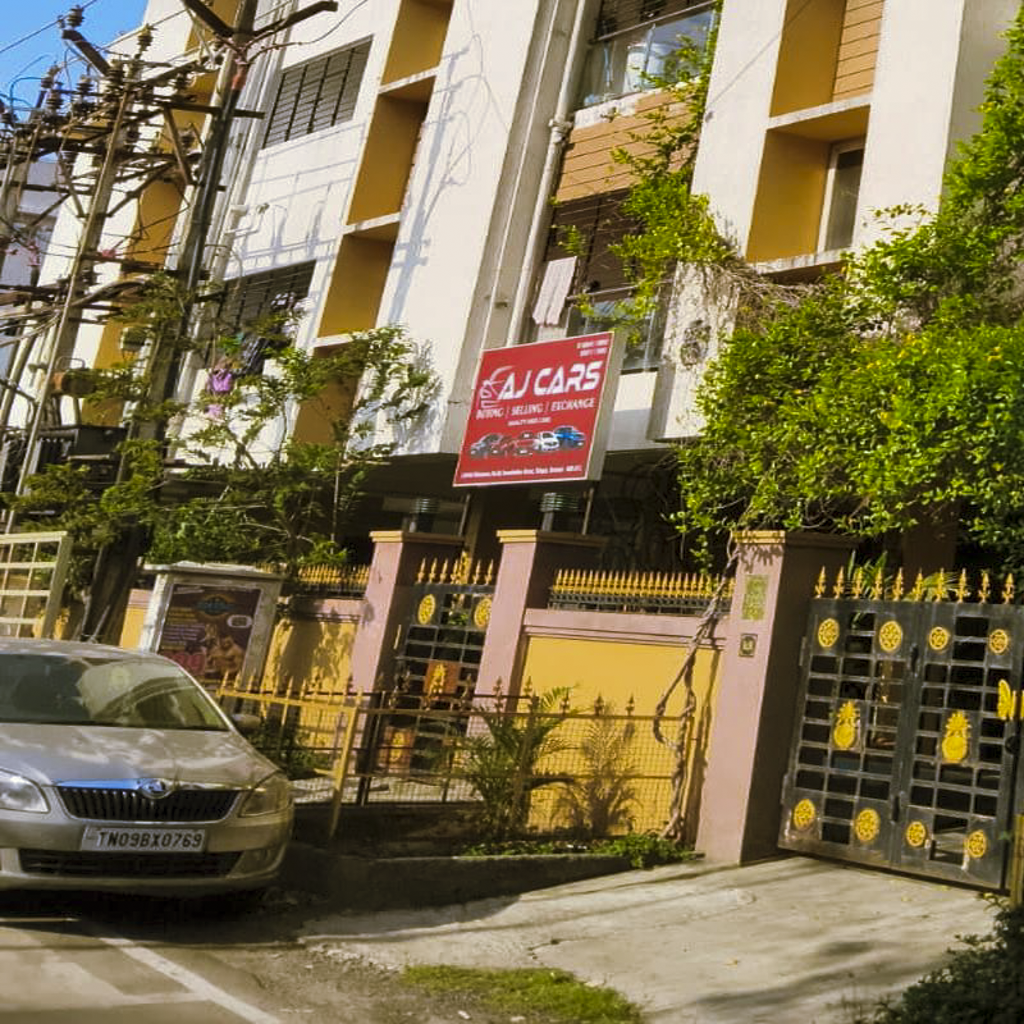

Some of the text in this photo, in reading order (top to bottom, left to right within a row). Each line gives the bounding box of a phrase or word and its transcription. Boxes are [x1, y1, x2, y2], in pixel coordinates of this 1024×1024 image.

[497, 361, 603, 400] AJ CARS
[511, 403, 544, 416] SELLING
[551, 397, 596, 412] EXCHANGE
[97, 831, 203, 848] TN09BX0769
